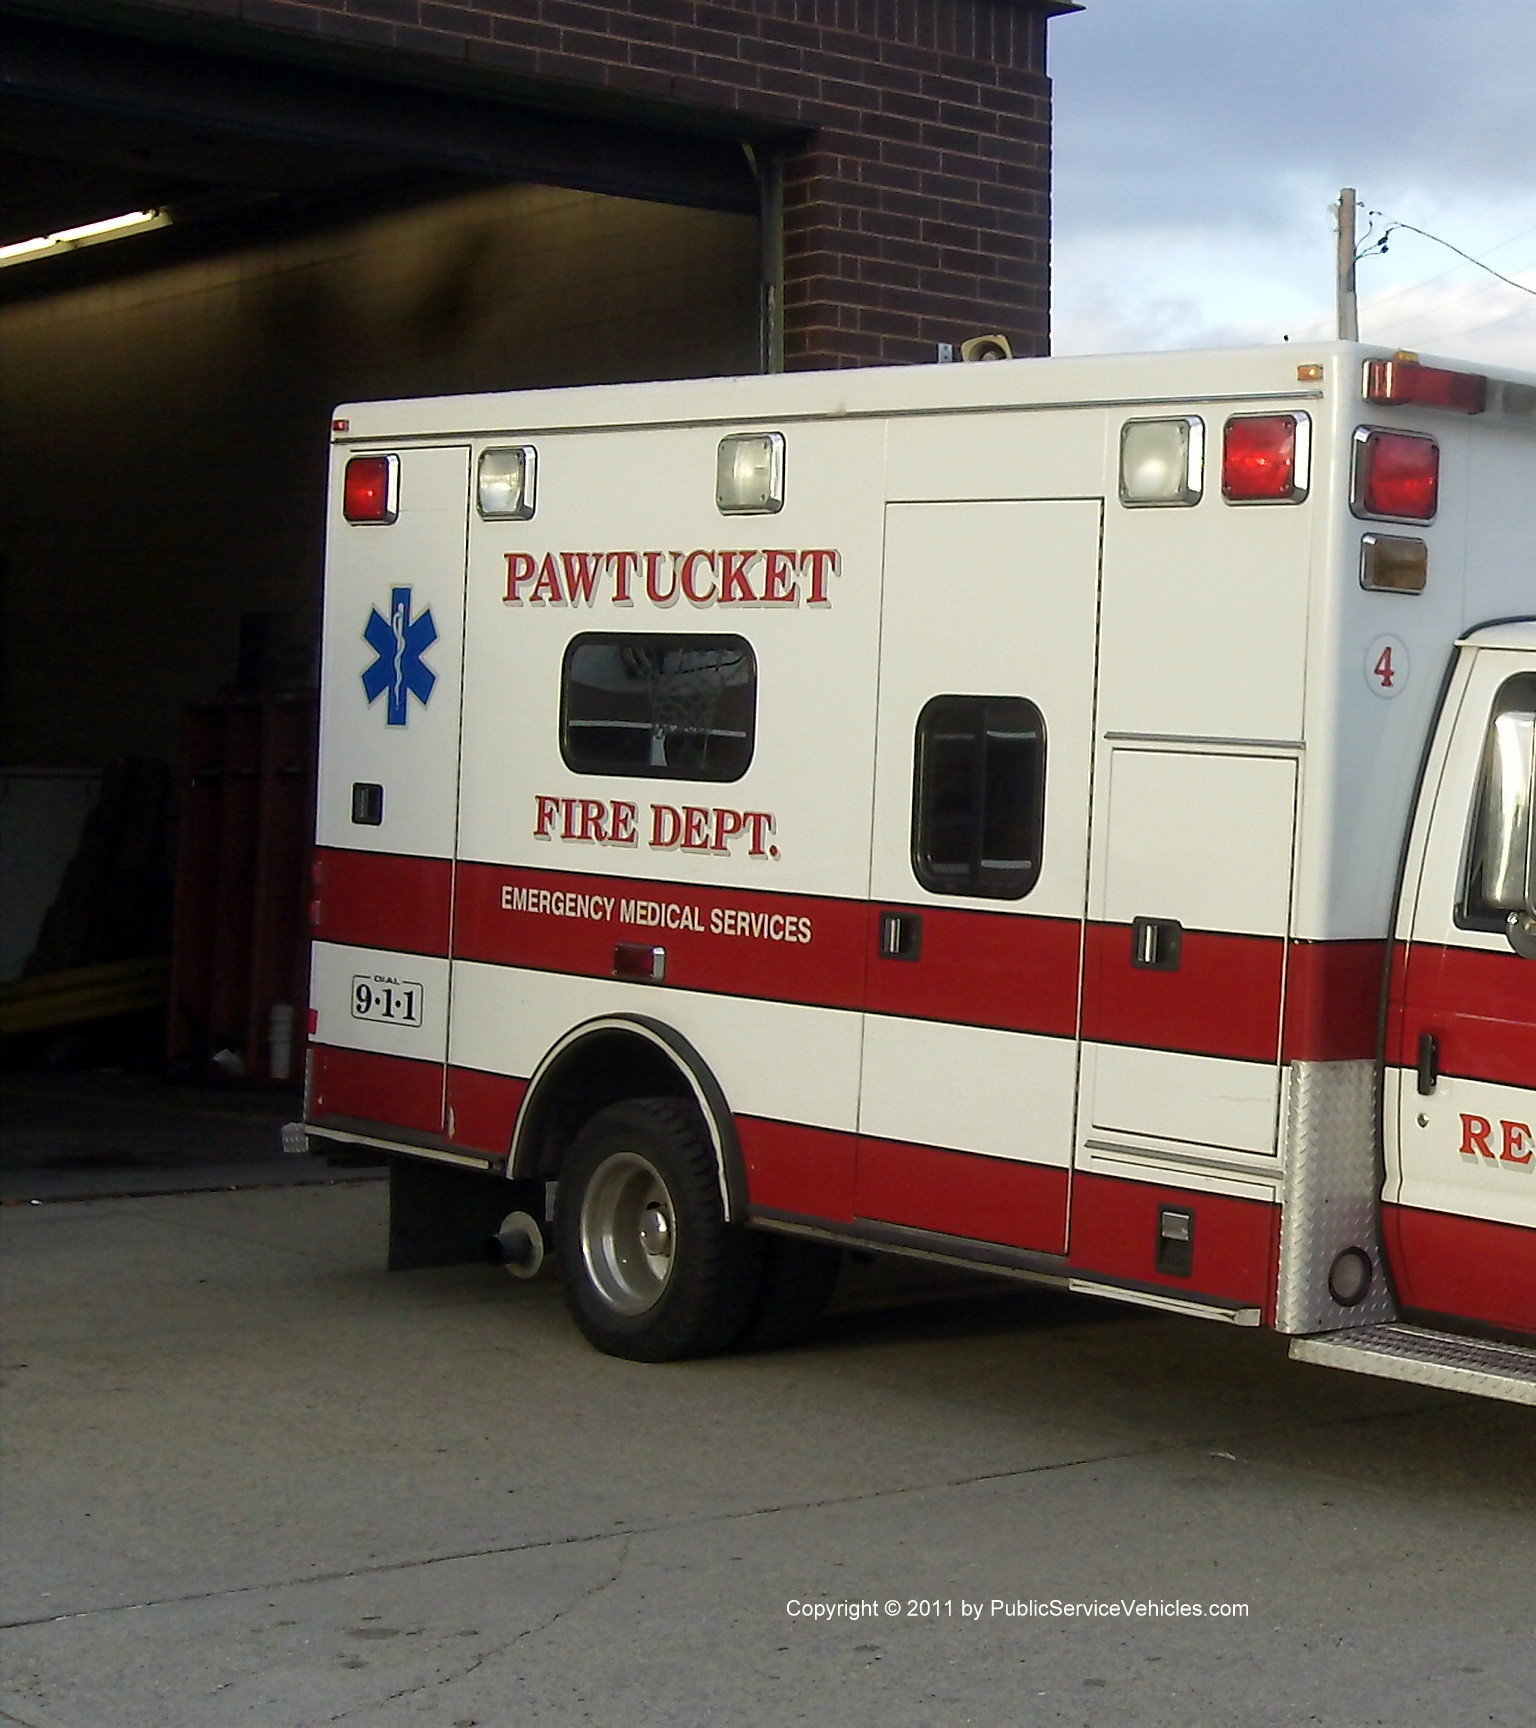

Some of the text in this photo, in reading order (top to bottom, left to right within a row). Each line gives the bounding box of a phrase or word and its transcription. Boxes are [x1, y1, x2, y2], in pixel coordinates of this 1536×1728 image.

[502, 549, 840, 607] PAWTUCKET
[1374, 646, 1395, 687] 4
[533, 795, 780, 861] FIRE DEPT.
[502, 886, 812, 944] EMERGENCY MEDICAL SERVICES
[374, 975, 400, 986] DIAL
